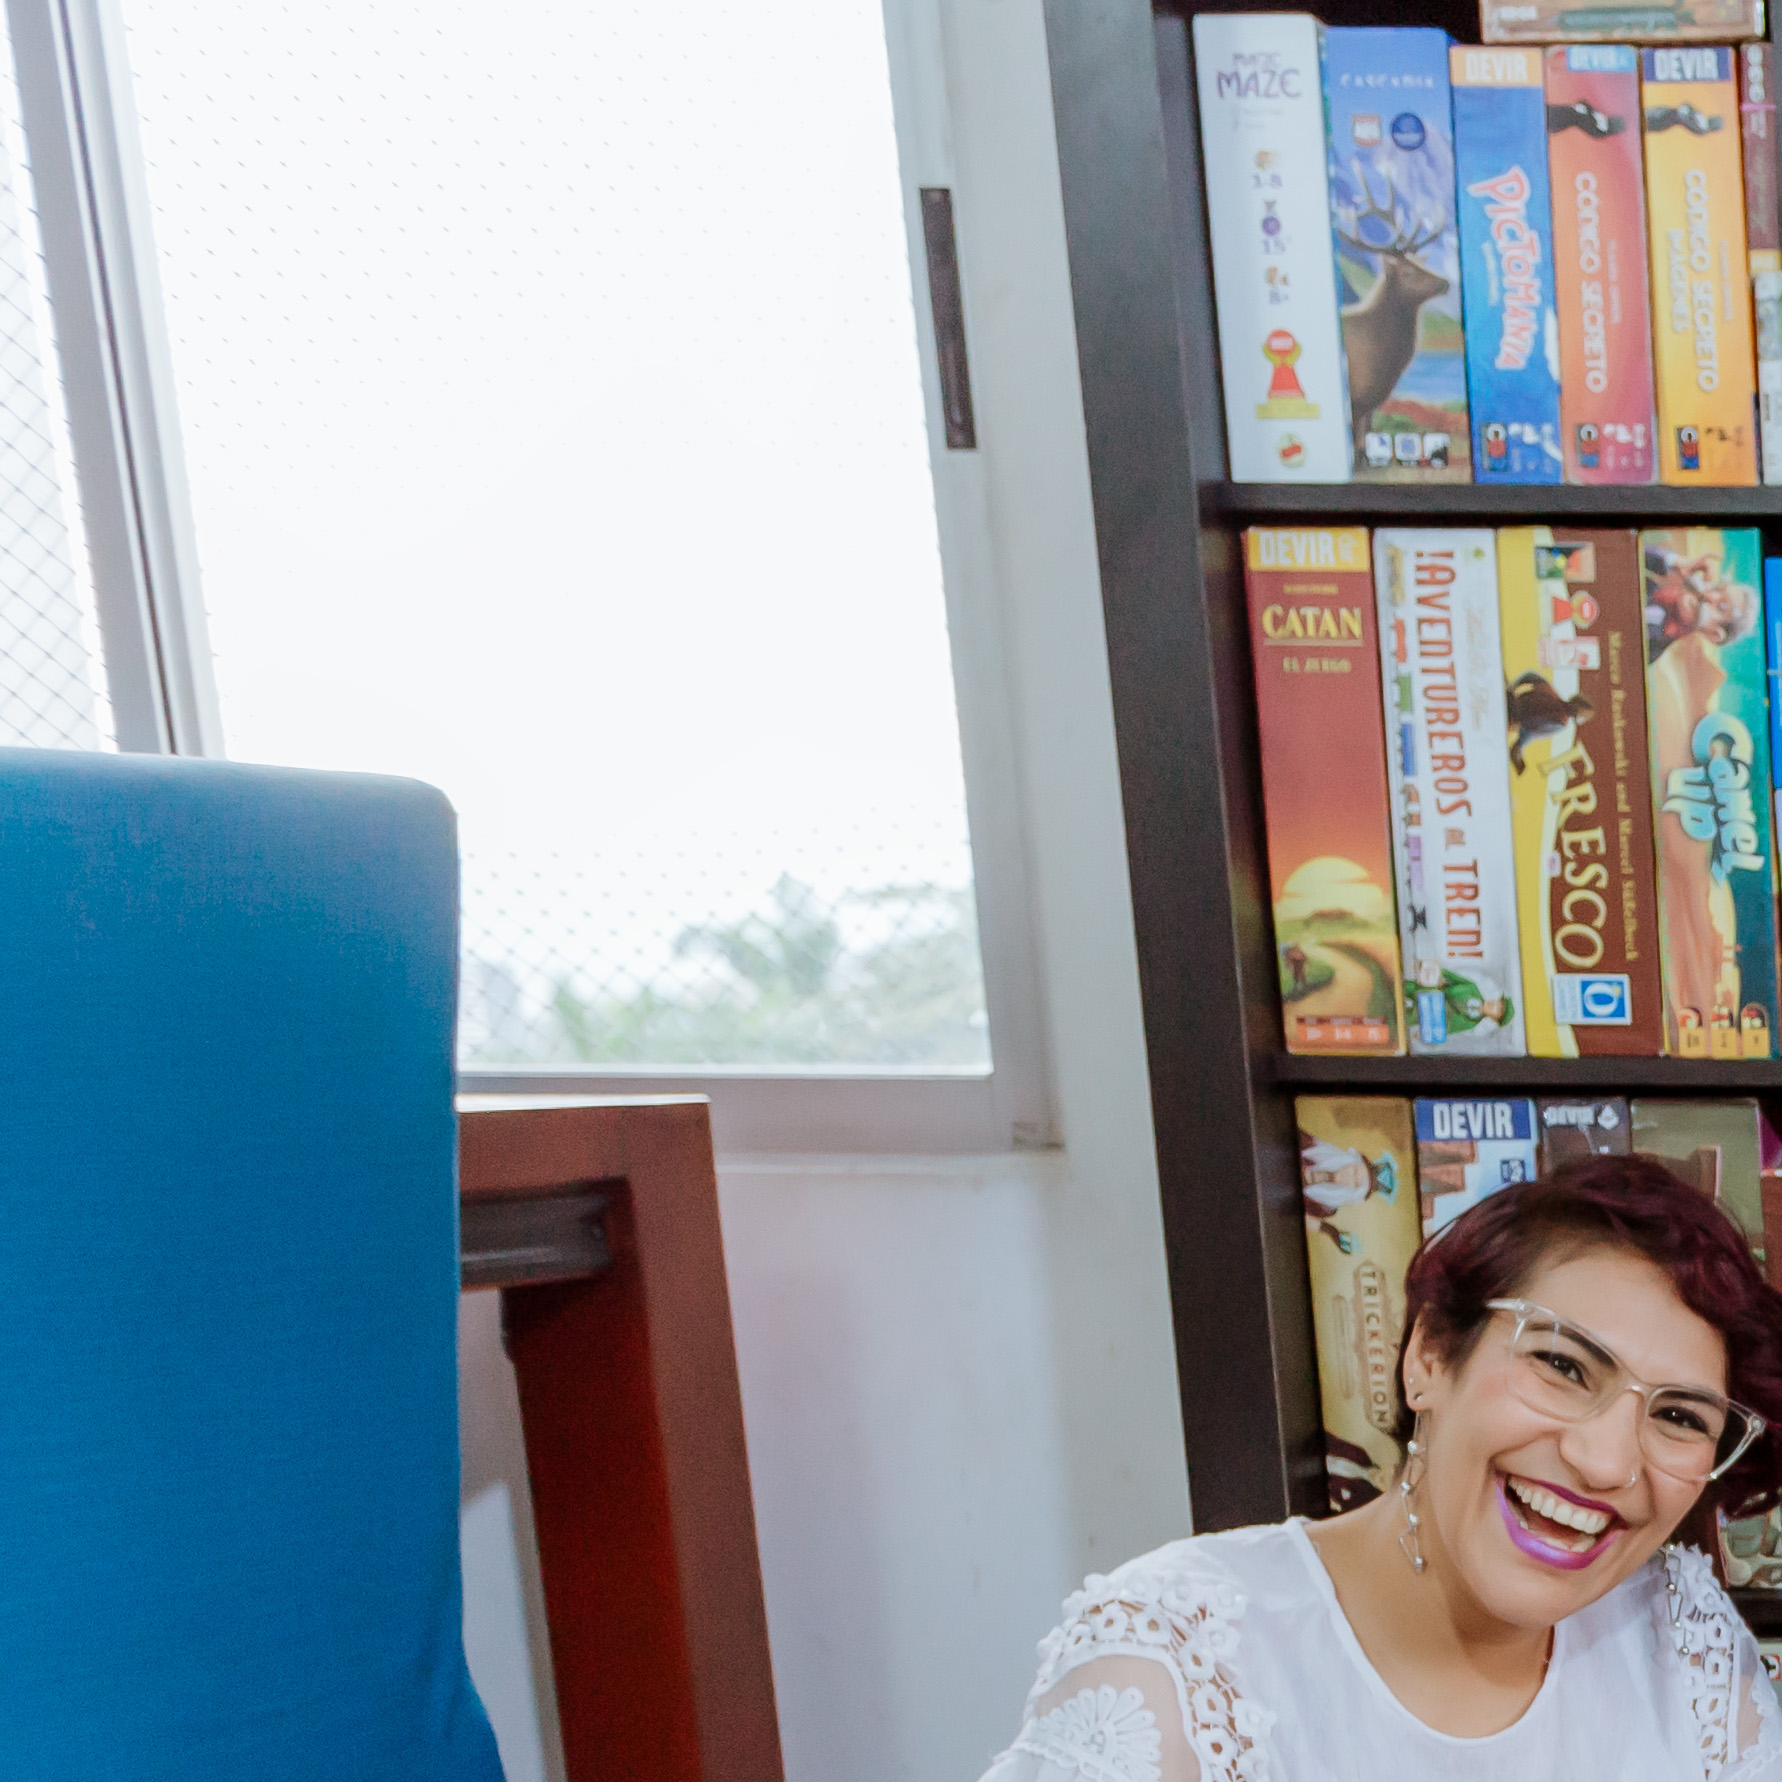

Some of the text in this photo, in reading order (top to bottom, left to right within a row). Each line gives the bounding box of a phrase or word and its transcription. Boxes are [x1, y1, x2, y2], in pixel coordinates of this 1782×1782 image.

[1217, 68, 1300, 99] MAZE
[1464, 52, 1528, 82] DEVIR
[1654, 50, 1719, 80] DEVIR
[1467, 165, 1542, 370] PICTOMANIA
[1580, 279, 1608, 393] SECRETO
[1691, 279, 1720, 392] SECRETO
[1259, 529, 1336, 567] DEVIR
[1262, 606, 1362, 640] CATAN
[1539, 740, 1610, 970] FRESCO
[1441, 856, 1485, 960] TREN!
[1433, 1104, 1514, 1139] DEVIR
[1361, 1270, 1387, 1424] TRICKERION
